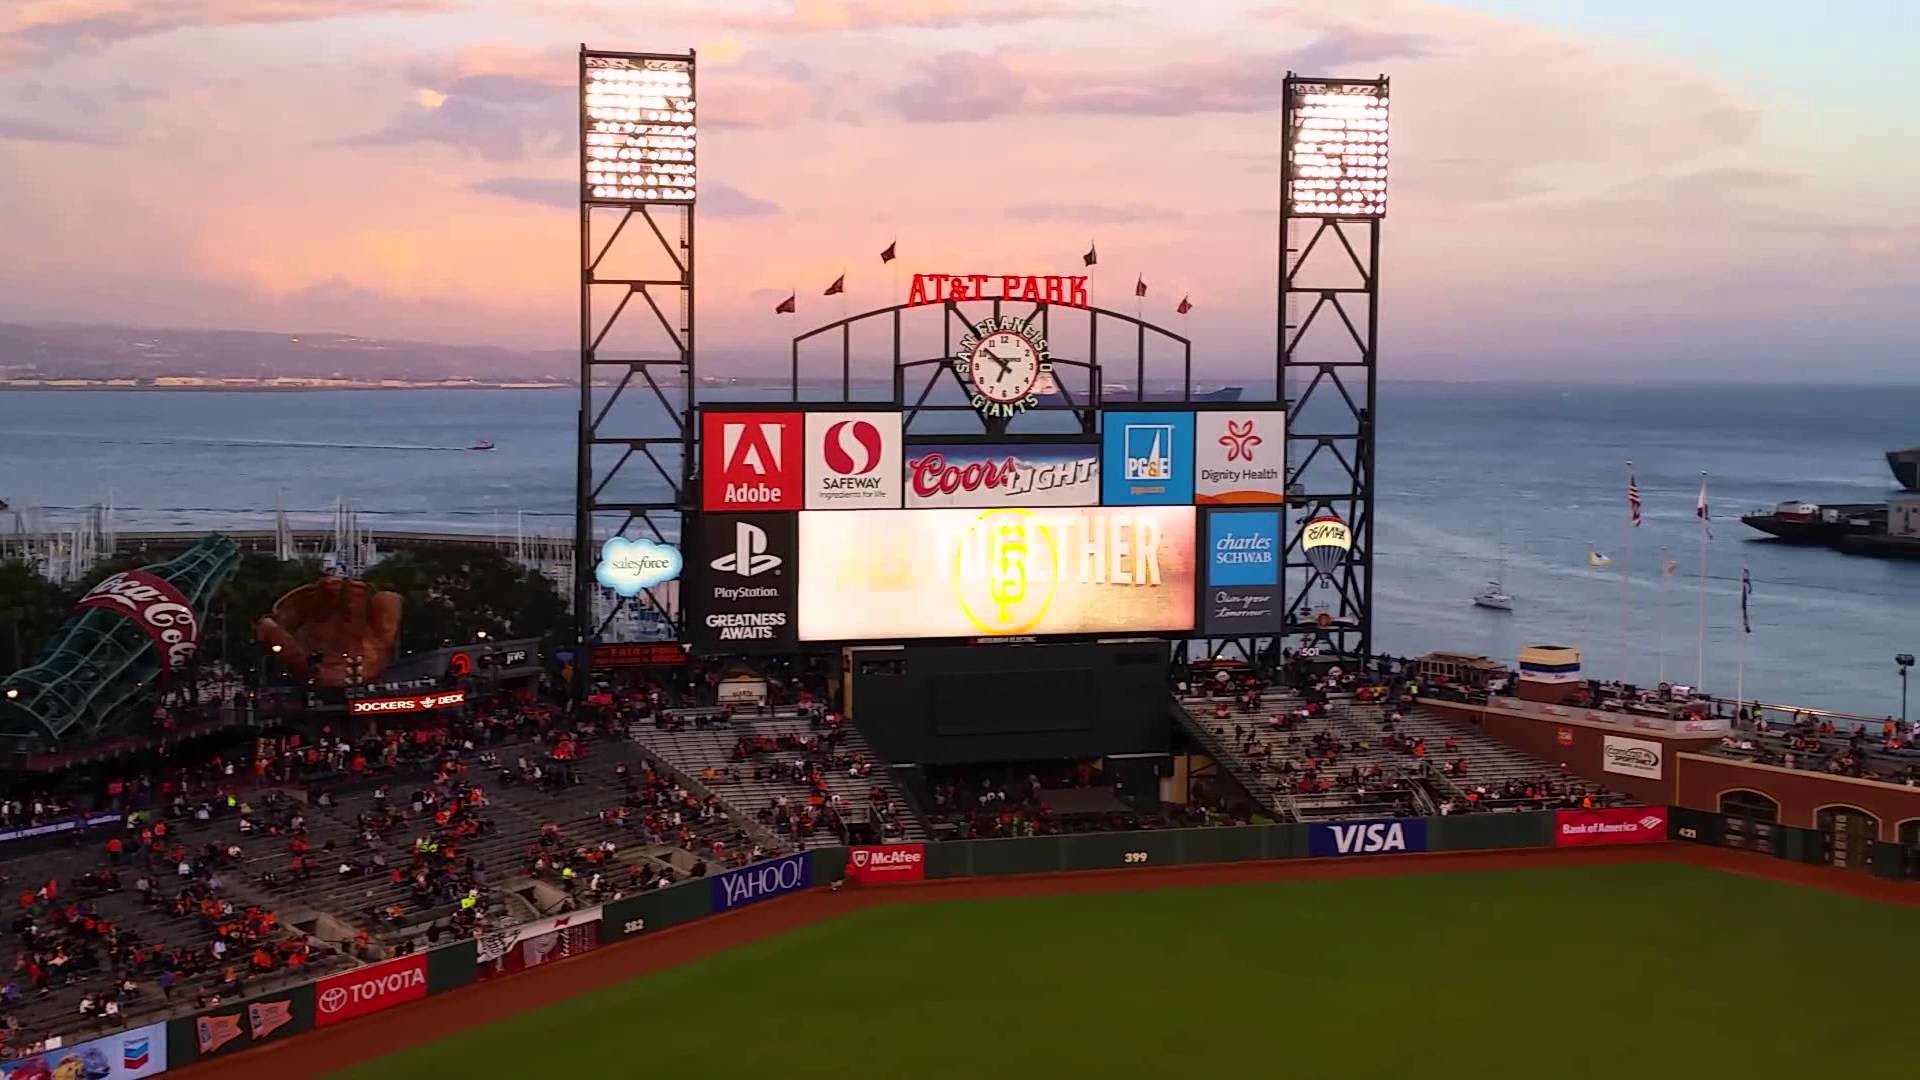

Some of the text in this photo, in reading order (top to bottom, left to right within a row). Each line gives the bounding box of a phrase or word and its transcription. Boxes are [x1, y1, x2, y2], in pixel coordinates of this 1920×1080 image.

[908, 274, 1088, 308] AT&T PARK
[956, 334, 980, 373] SAN
[972, 394, 1038, 417] GIANTS
[910, 453, 1097, 497] Coors LIGHT
[1129, 457, 1168, 477] PG&E
[823, 477, 881, 489] SAFEWAY
[1201, 469, 1278, 482] Dignity Health
[724, 483, 781, 503] Adobe
[1217, 532, 1272, 550] charles
[612, 556, 669, 575] salesforce
[1216, 551, 1272, 564] SCHWAB
[714, 587, 778, 600] PlayStation
[706, 613, 786, 626] GREATNESS
[720, 626, 773, 640] AWAITS
[1301, 647, 1319, 657] 501
[438, 694, 464, 705] DECK
[1562, 822, 1638, 835] Bank of America
[1327, 822, 1406, 854] VISA
[870, 850, 921, 865] McAfee
[1124, 852, 1148, 863] 399
[721, 858, 804, 906] YAHOO!
[350, 967, 425, 1002] TOYOTA
